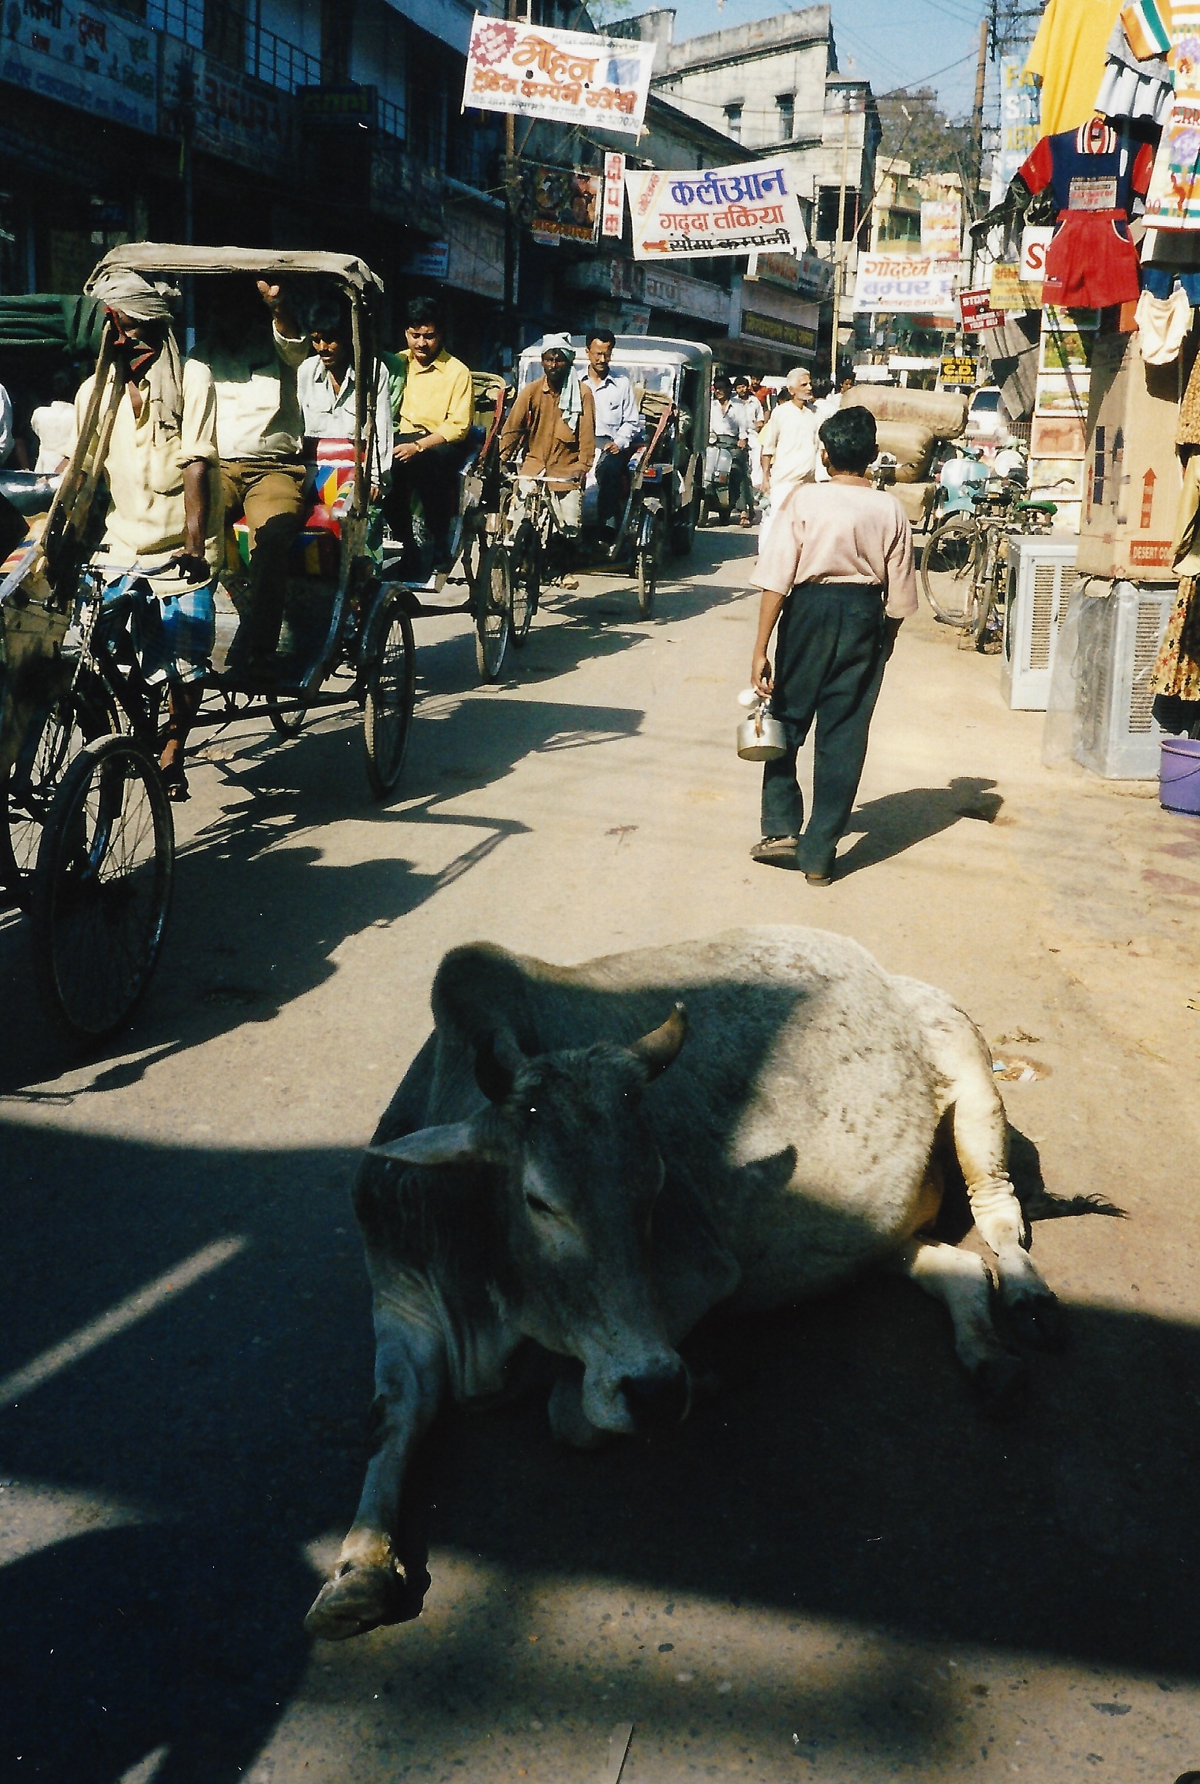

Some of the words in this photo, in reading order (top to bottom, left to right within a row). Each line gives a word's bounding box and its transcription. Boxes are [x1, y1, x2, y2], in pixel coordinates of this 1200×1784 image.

[512, 35, 599, 84] मोहन
[1005, 66, 1034, 89] FA
[659, 213, 709, 235] गद्दा
[713, 204, 785, 229] तकिया
[863, 279, 931, 295] बम्पर
[944, 364, 974, 375] C.D.
[1133, 546, 1158, 560] DESERT
